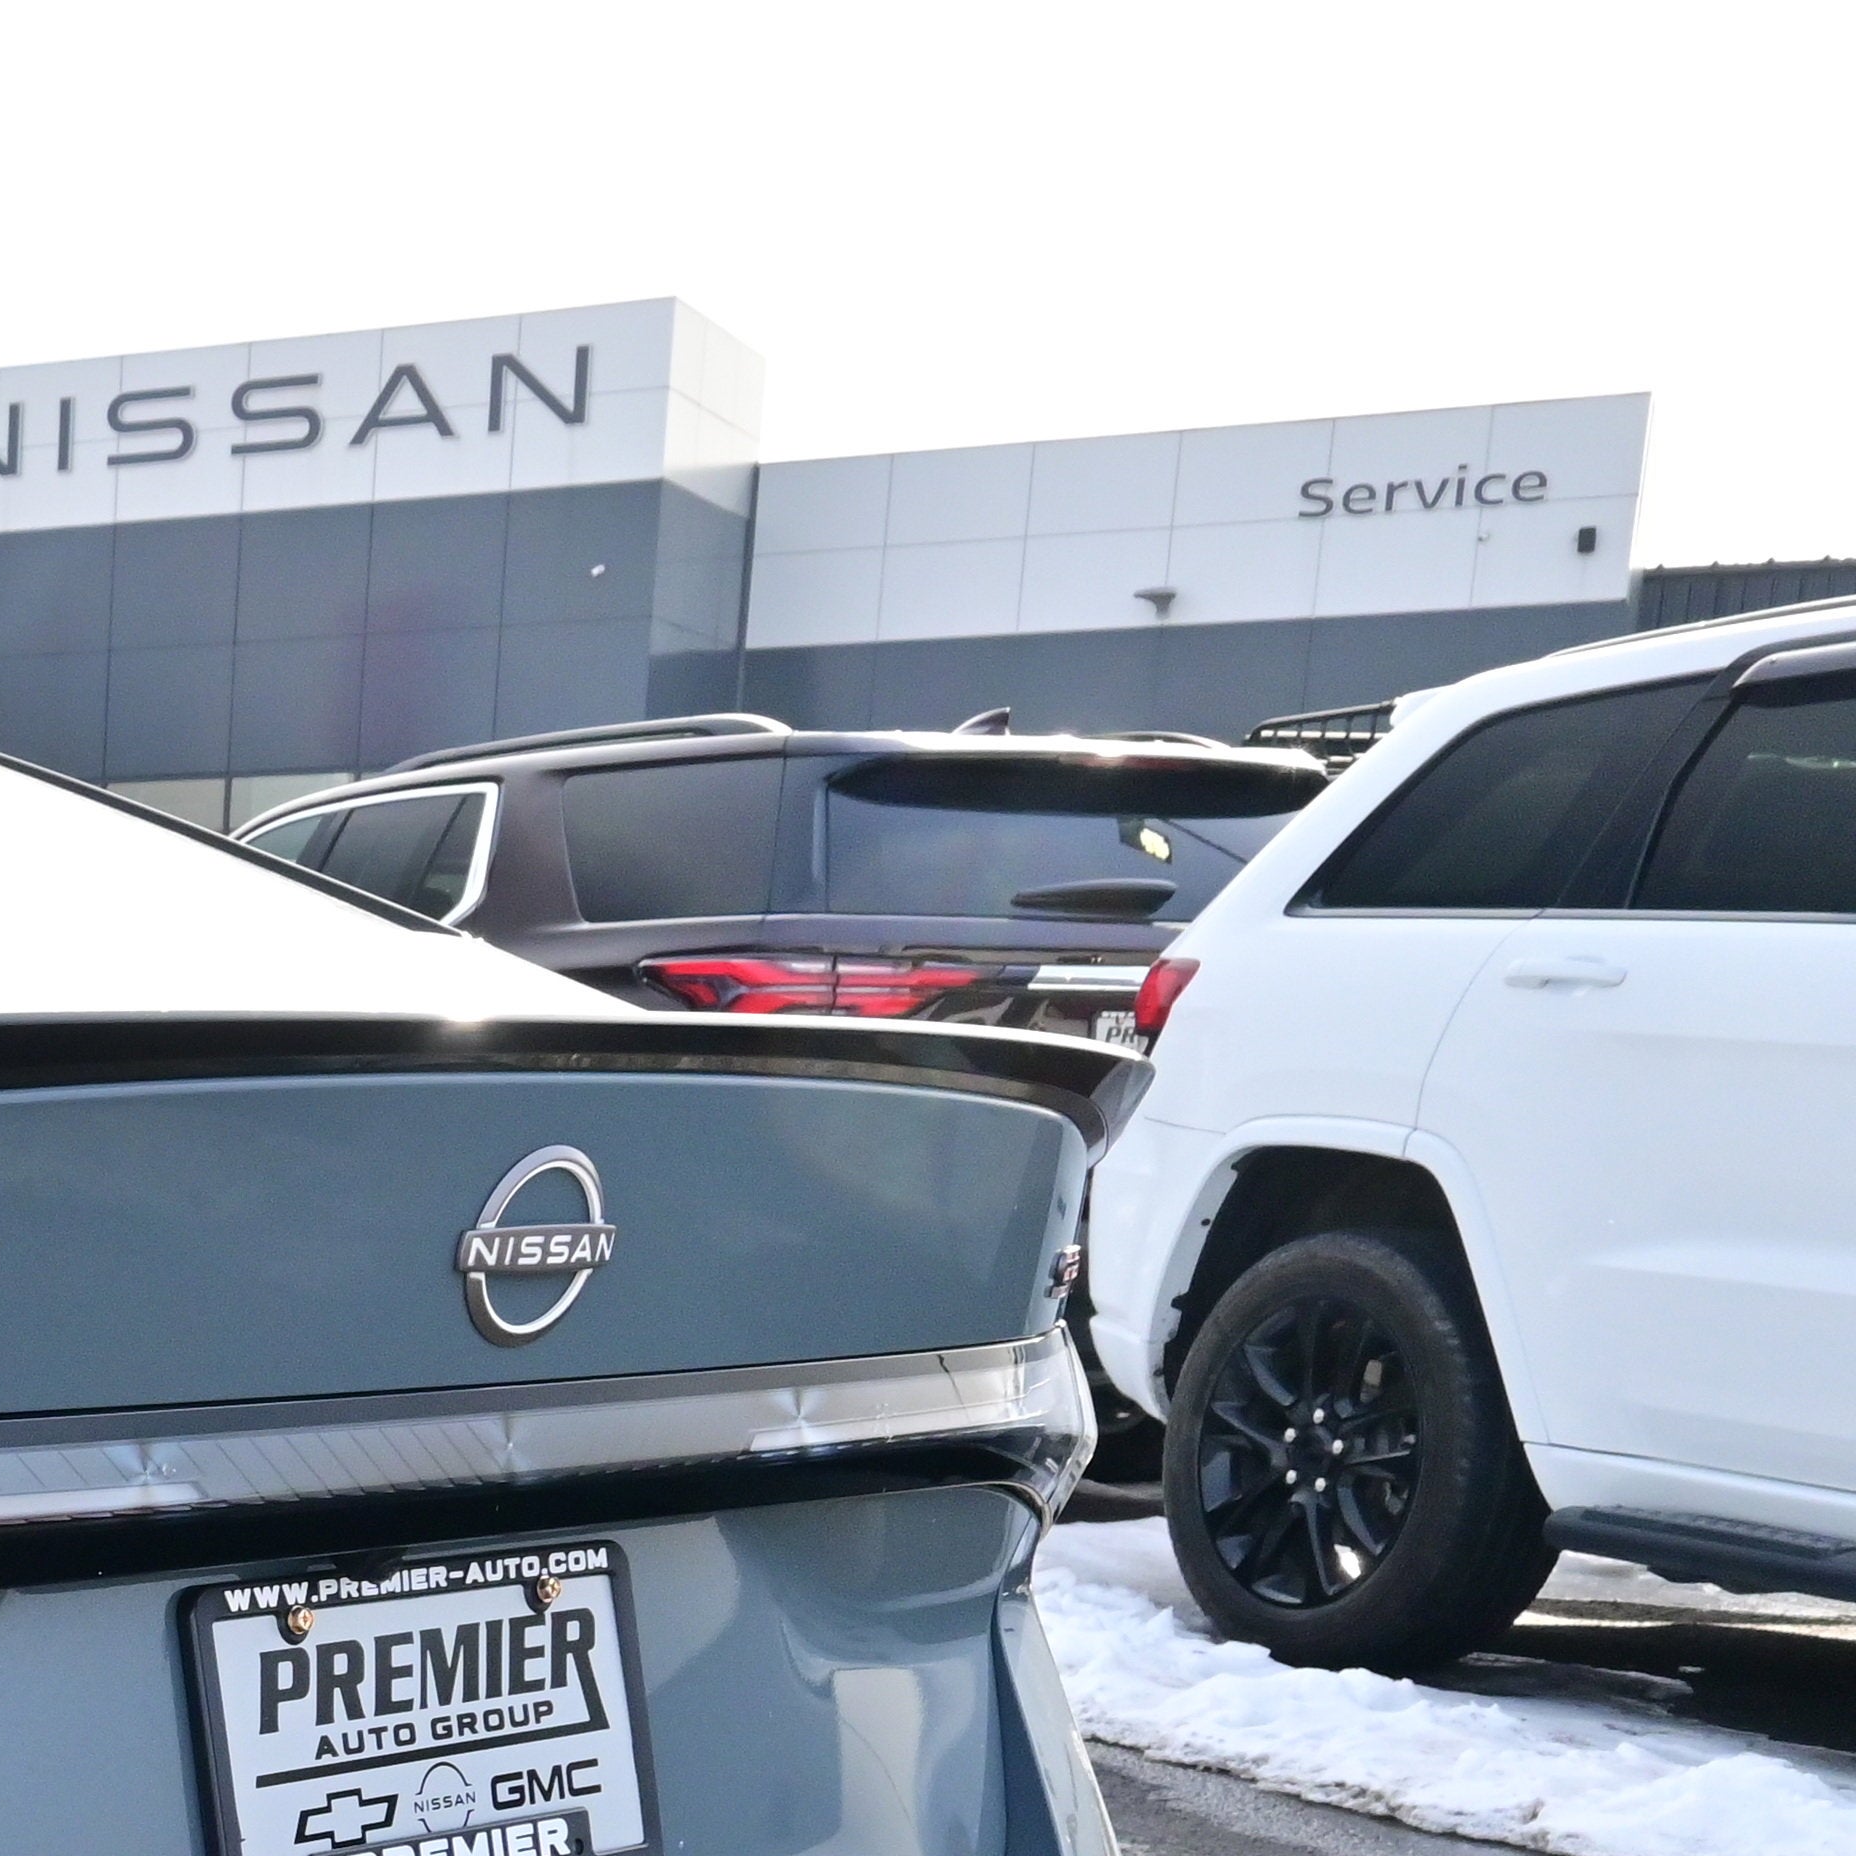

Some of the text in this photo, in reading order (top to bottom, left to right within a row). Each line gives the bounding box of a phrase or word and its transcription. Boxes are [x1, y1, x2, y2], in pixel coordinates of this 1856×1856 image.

[1297, 462, 1549, 519] Service
[466, 1231, 616, 1267] NISSAN
[224, 1547, 609, 1613] WWW.PREMIER-AUTO.COM
[258, 1607, 604, 1735] PREMIER
[314, 1699, 555, 1761] AUTO GROUP
[413, 1757, 603, 1814] NISSAN GMC
